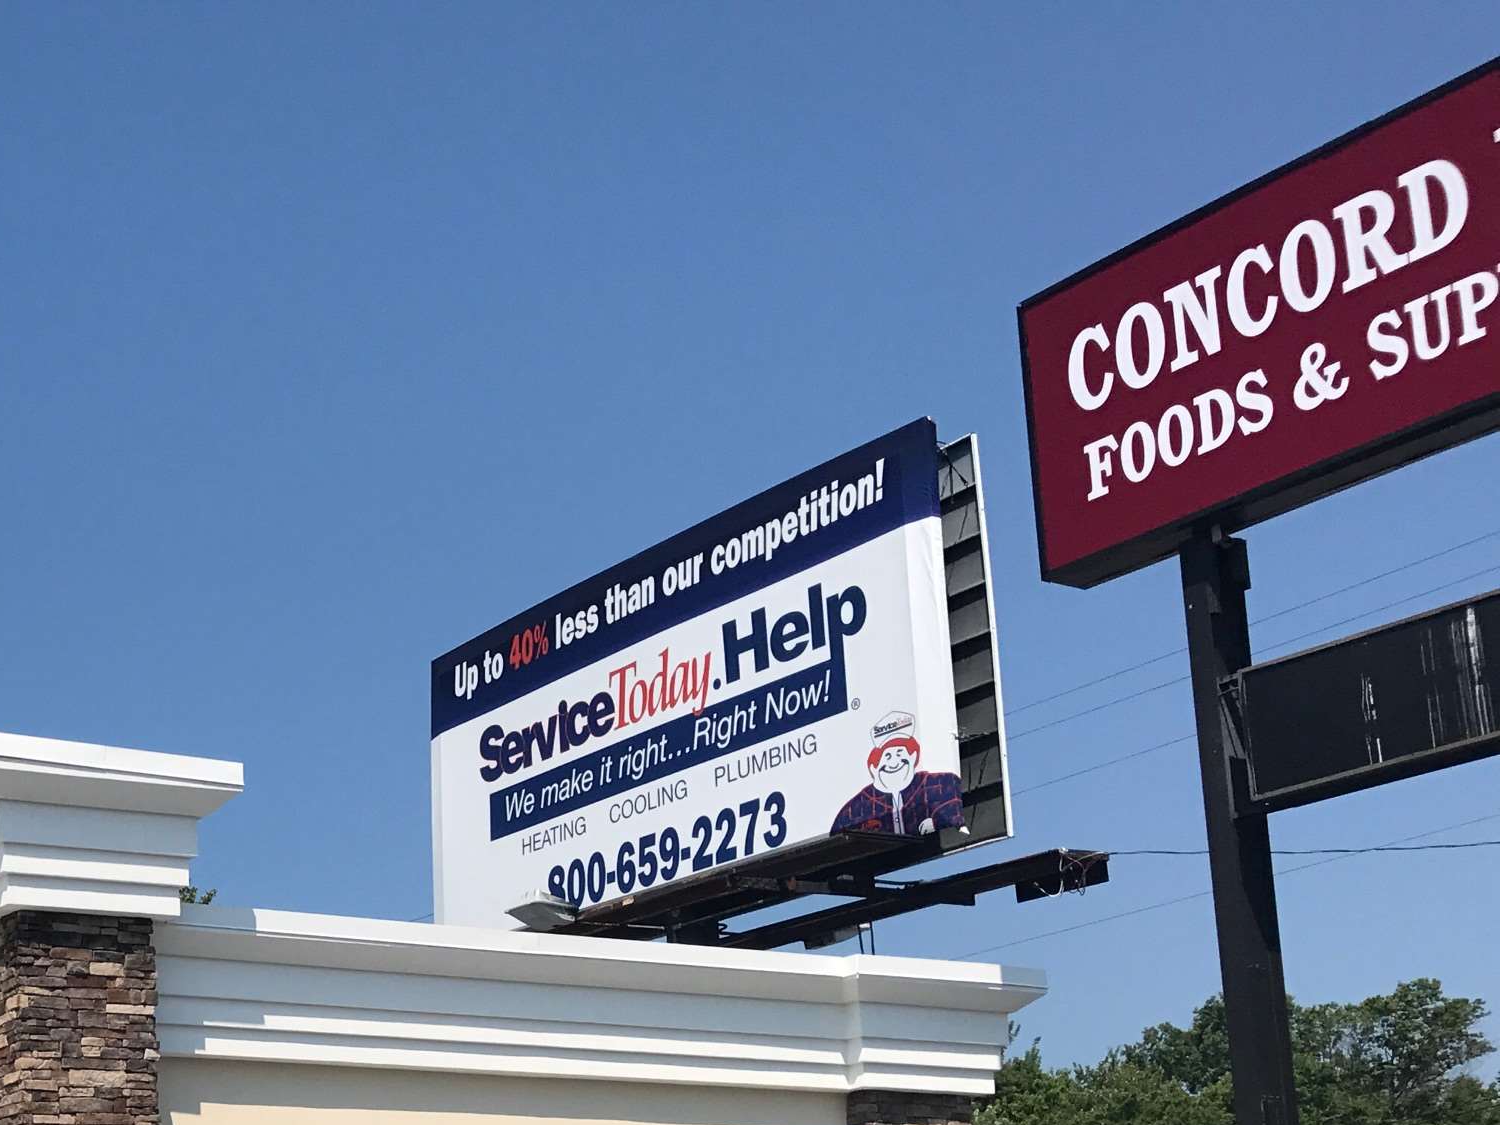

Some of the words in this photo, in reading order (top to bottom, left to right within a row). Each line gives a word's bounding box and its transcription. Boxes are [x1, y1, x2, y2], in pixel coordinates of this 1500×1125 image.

[1067, 158, 1469, 411] CONCORD
[1083, 369, 1274, 501] FOODS
[1293, 341, 1350, 411] &
[1367, 263, 1500, 380] SUP
[455, 661, 479, 700] Up
[483, 650, 504, 684] to
[509, 620, 549, 670] 40%
[555, 604, 599, 649] less
[604, 576, 655, 624] than
[662, 552, 703, 597] our
[710, 457, 885, 575] competition!
[505, 788, 535, 822] We
[541, 769, 593, 809] make
[600, 755, 613, 786] it
[765, 669, 831, 724] Now!
[522, 816, 587, 856] HEATING
[609, 779, 688, 824] COOLING
[714, 733, 817, 787] PLUMBING
[548, 791, 787, 908] 800-659-2273
